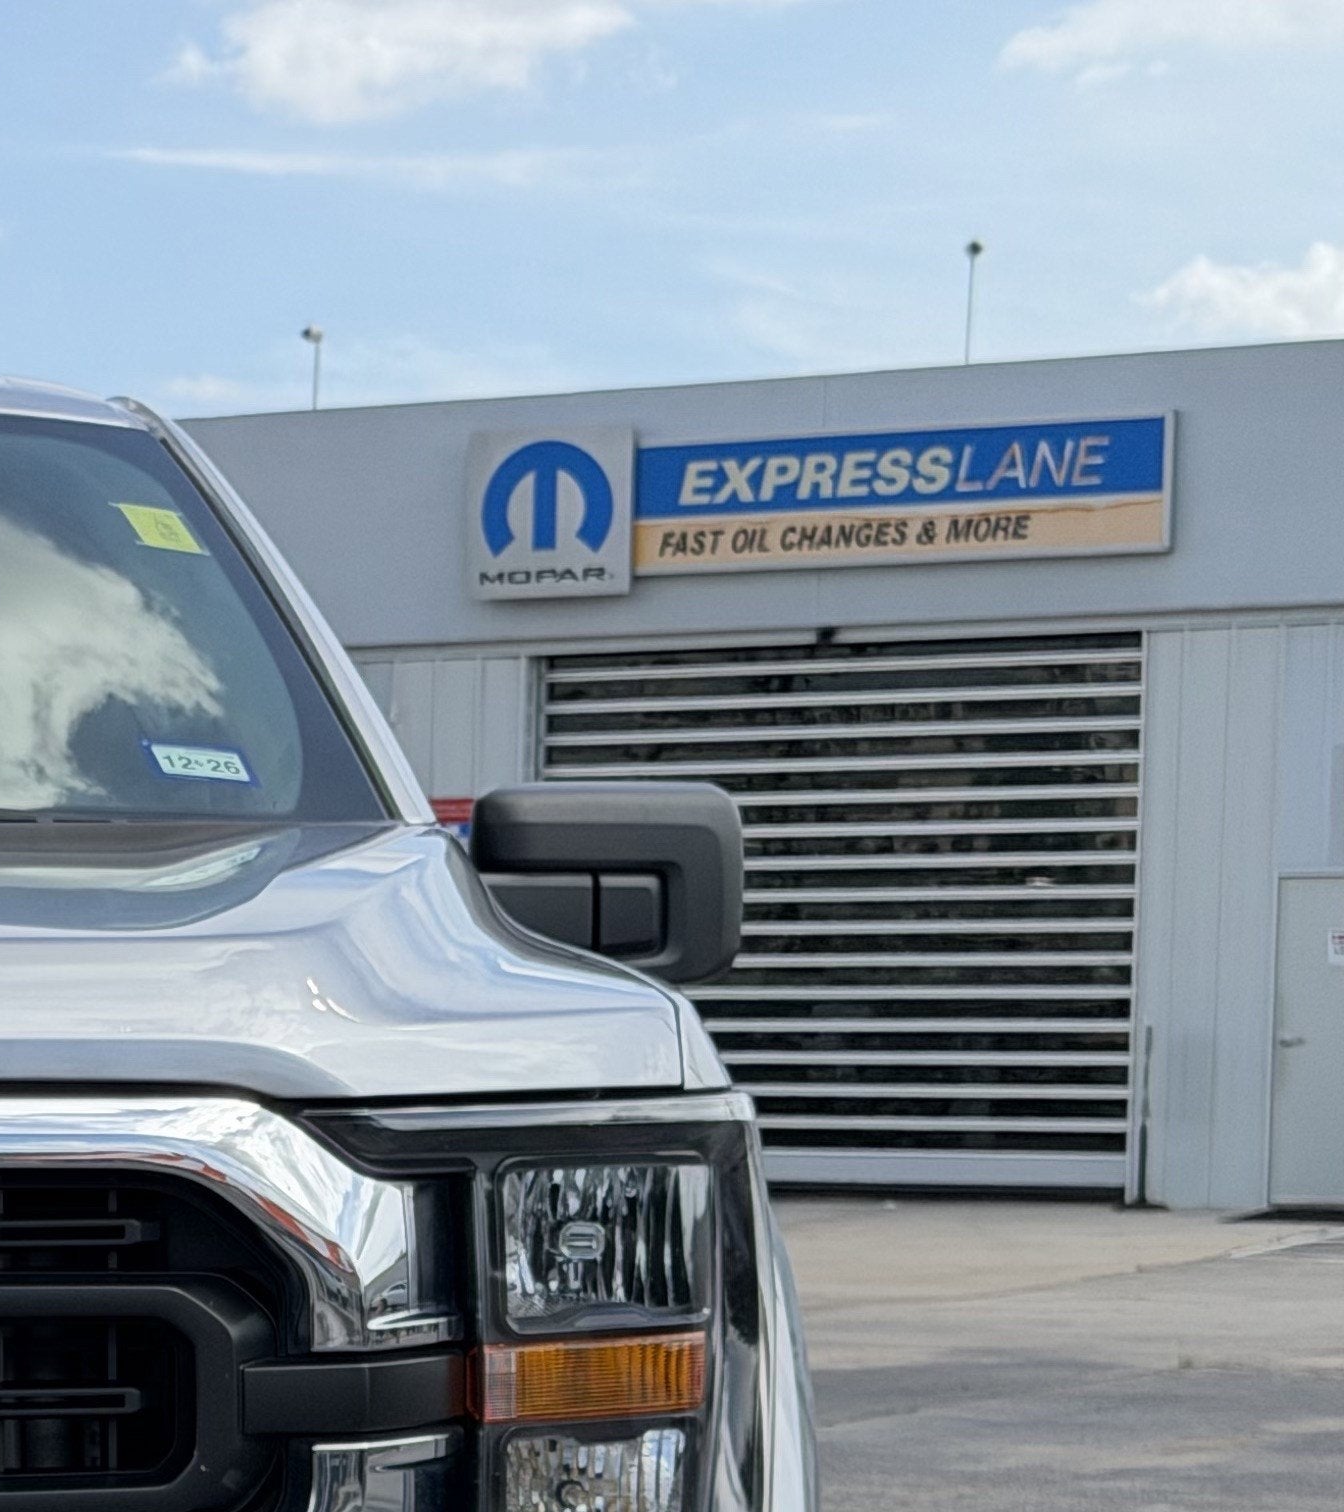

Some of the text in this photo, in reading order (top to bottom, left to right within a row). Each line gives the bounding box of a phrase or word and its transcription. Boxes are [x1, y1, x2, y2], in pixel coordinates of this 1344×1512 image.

[658, 514, 1031, 558] FAST OIL CHANGES & MORE
[478, 566, 607, 586] MOPAR
